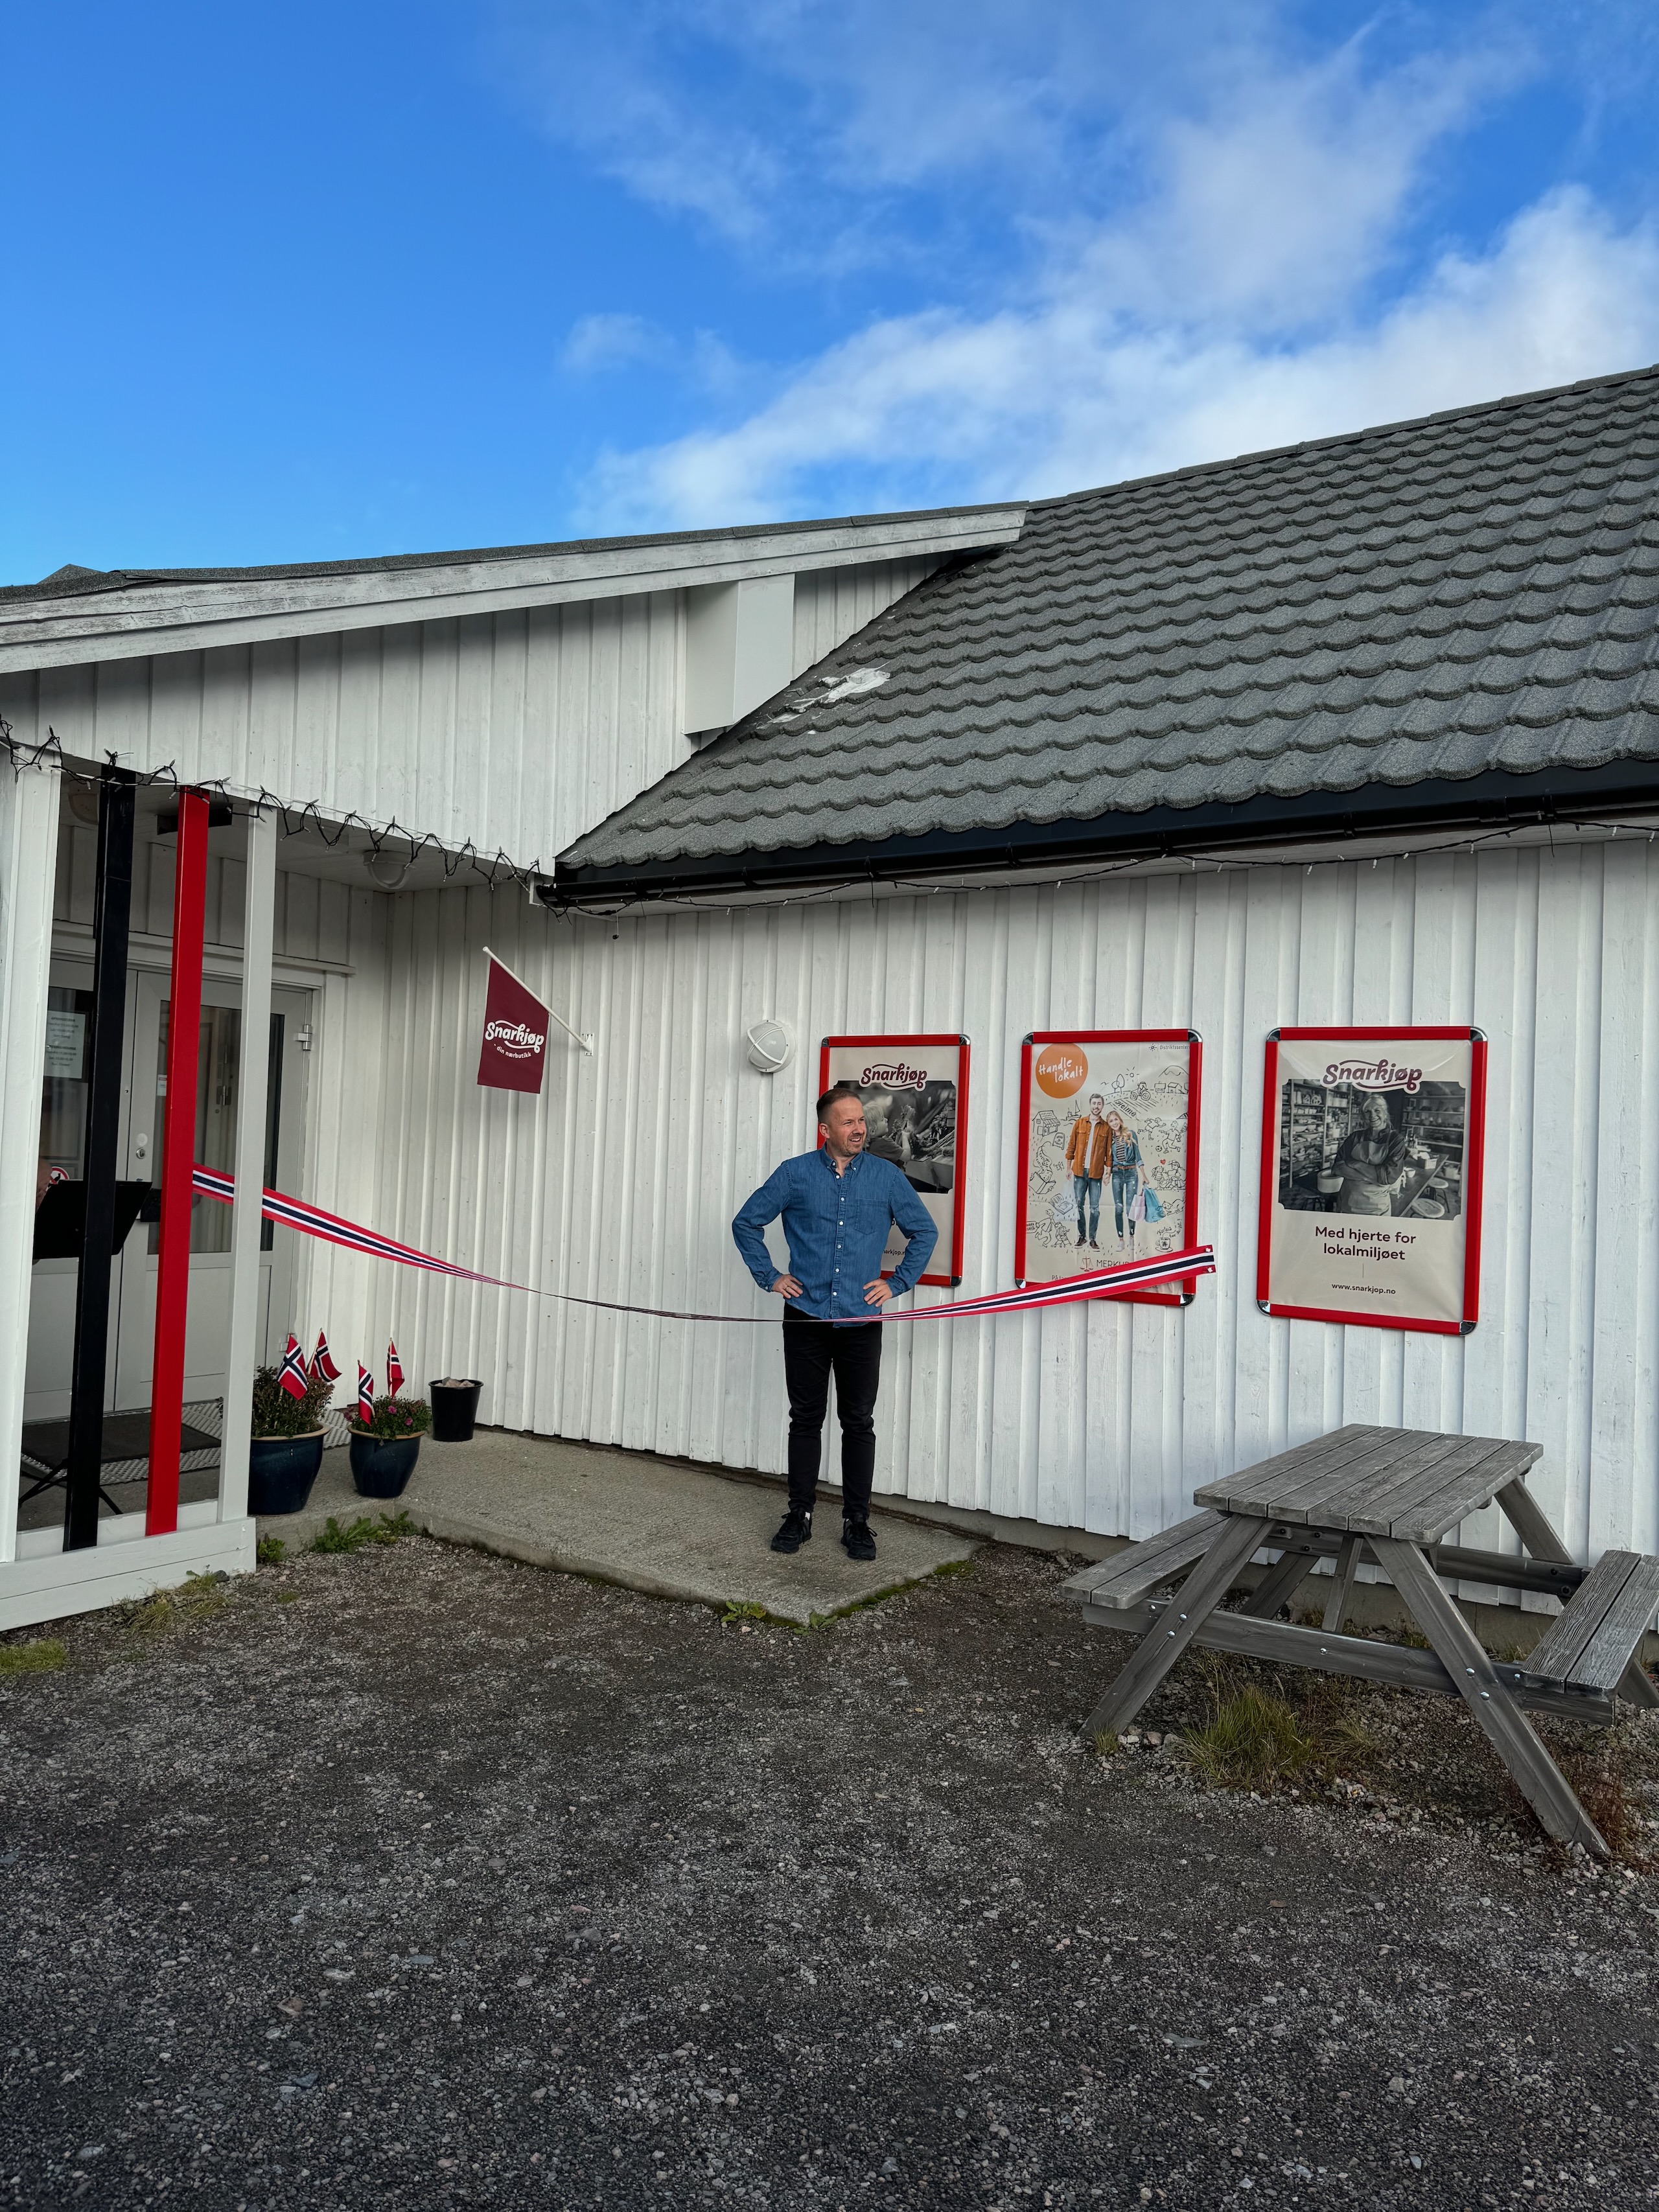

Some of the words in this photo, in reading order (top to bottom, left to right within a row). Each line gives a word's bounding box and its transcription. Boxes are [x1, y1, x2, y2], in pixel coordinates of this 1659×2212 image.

[485, 1020, 544, 1054] Snarkjøp
[496, 1046, 505, 1054] din
[1039, 1057, 1073, 1076] Handle
[1055, 1065, 1084, 1083] lokalt
[1323, 1059, 1422, 1090] Snarkjøp
[861, 1063, 927, 1089] Snarkjøp
[1315, 1226, 1344, 1238] Med
[1349, 1228, 1391, 1243] hjerte
[1395, 1232, 1416, 1243] for
[1323, 1243, 1406, 1261] lokalmiljøet
[1096, 1260, 1129, 1268] MERK
[1332, 1284, 1396, 1295] www.snarkjop.no
